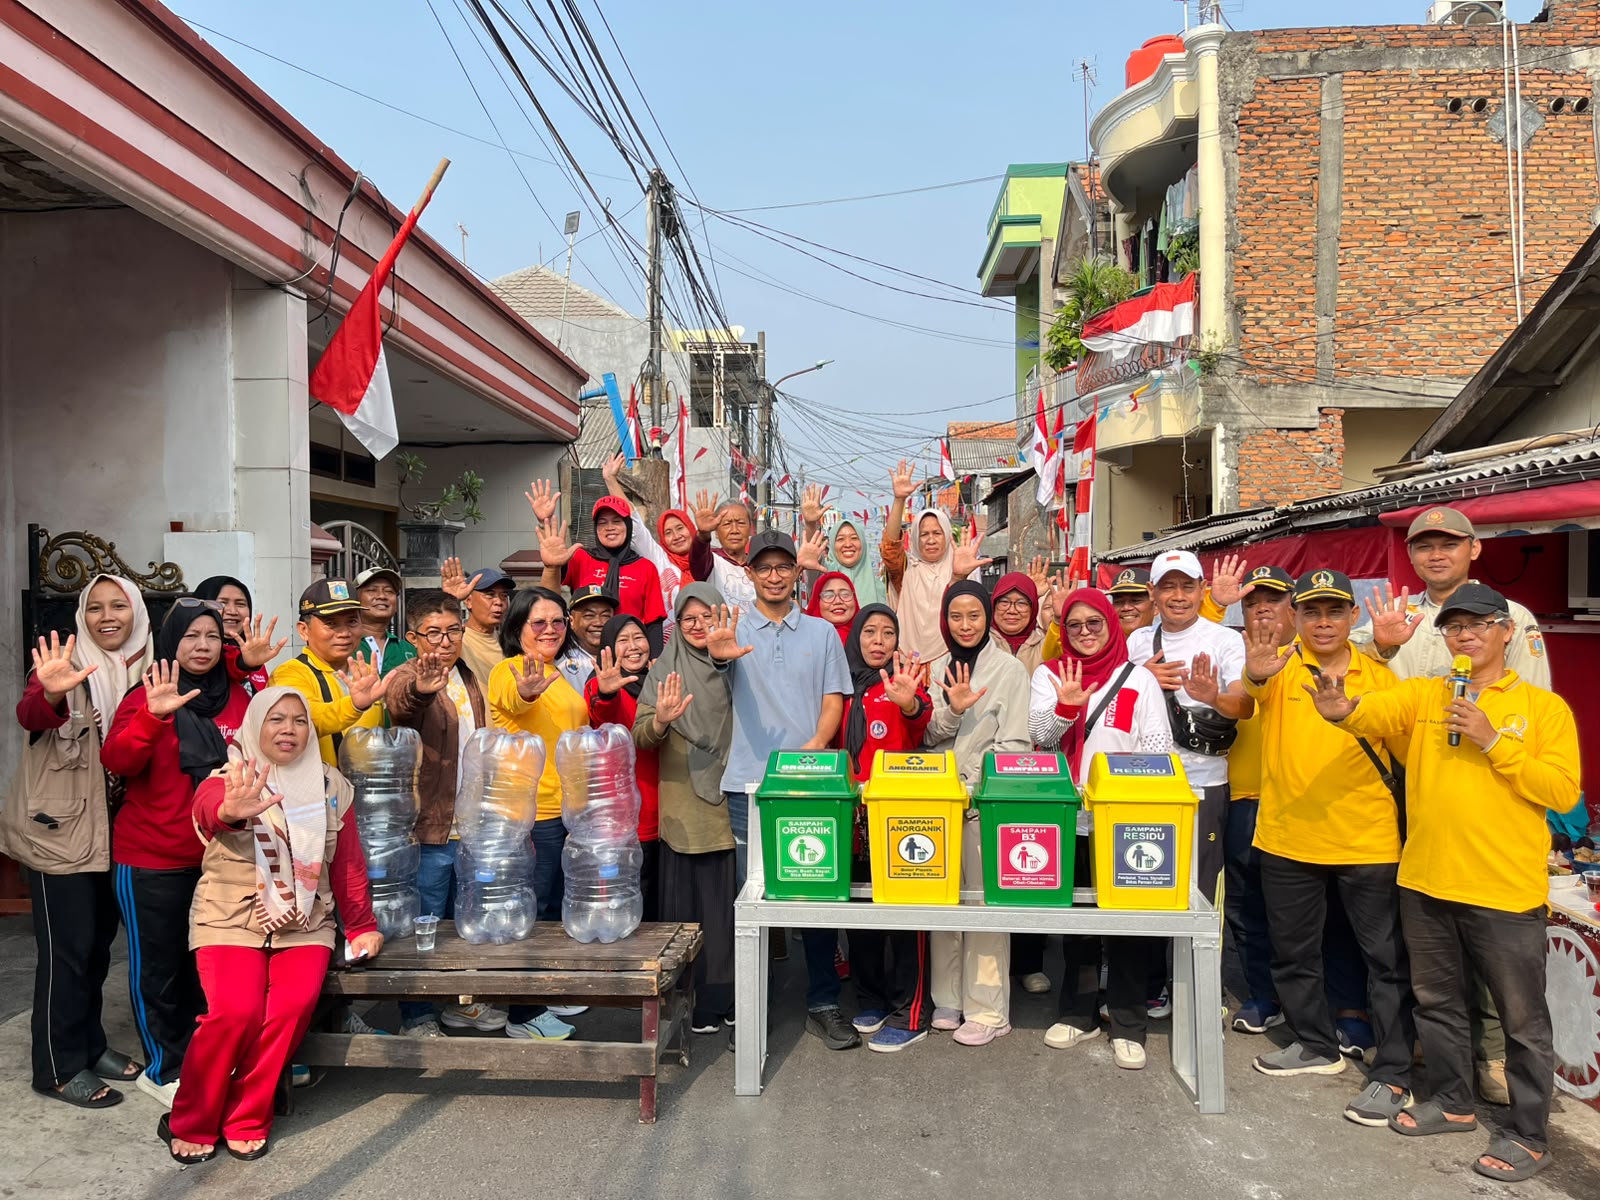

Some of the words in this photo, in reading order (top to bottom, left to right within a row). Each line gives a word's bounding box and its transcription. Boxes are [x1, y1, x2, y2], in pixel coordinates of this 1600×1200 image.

[781, 826, 831, 835] ORGANIK
[1021, 833, 1036, 841] B3
[1123, 832, 1165, 841] RESIDU
